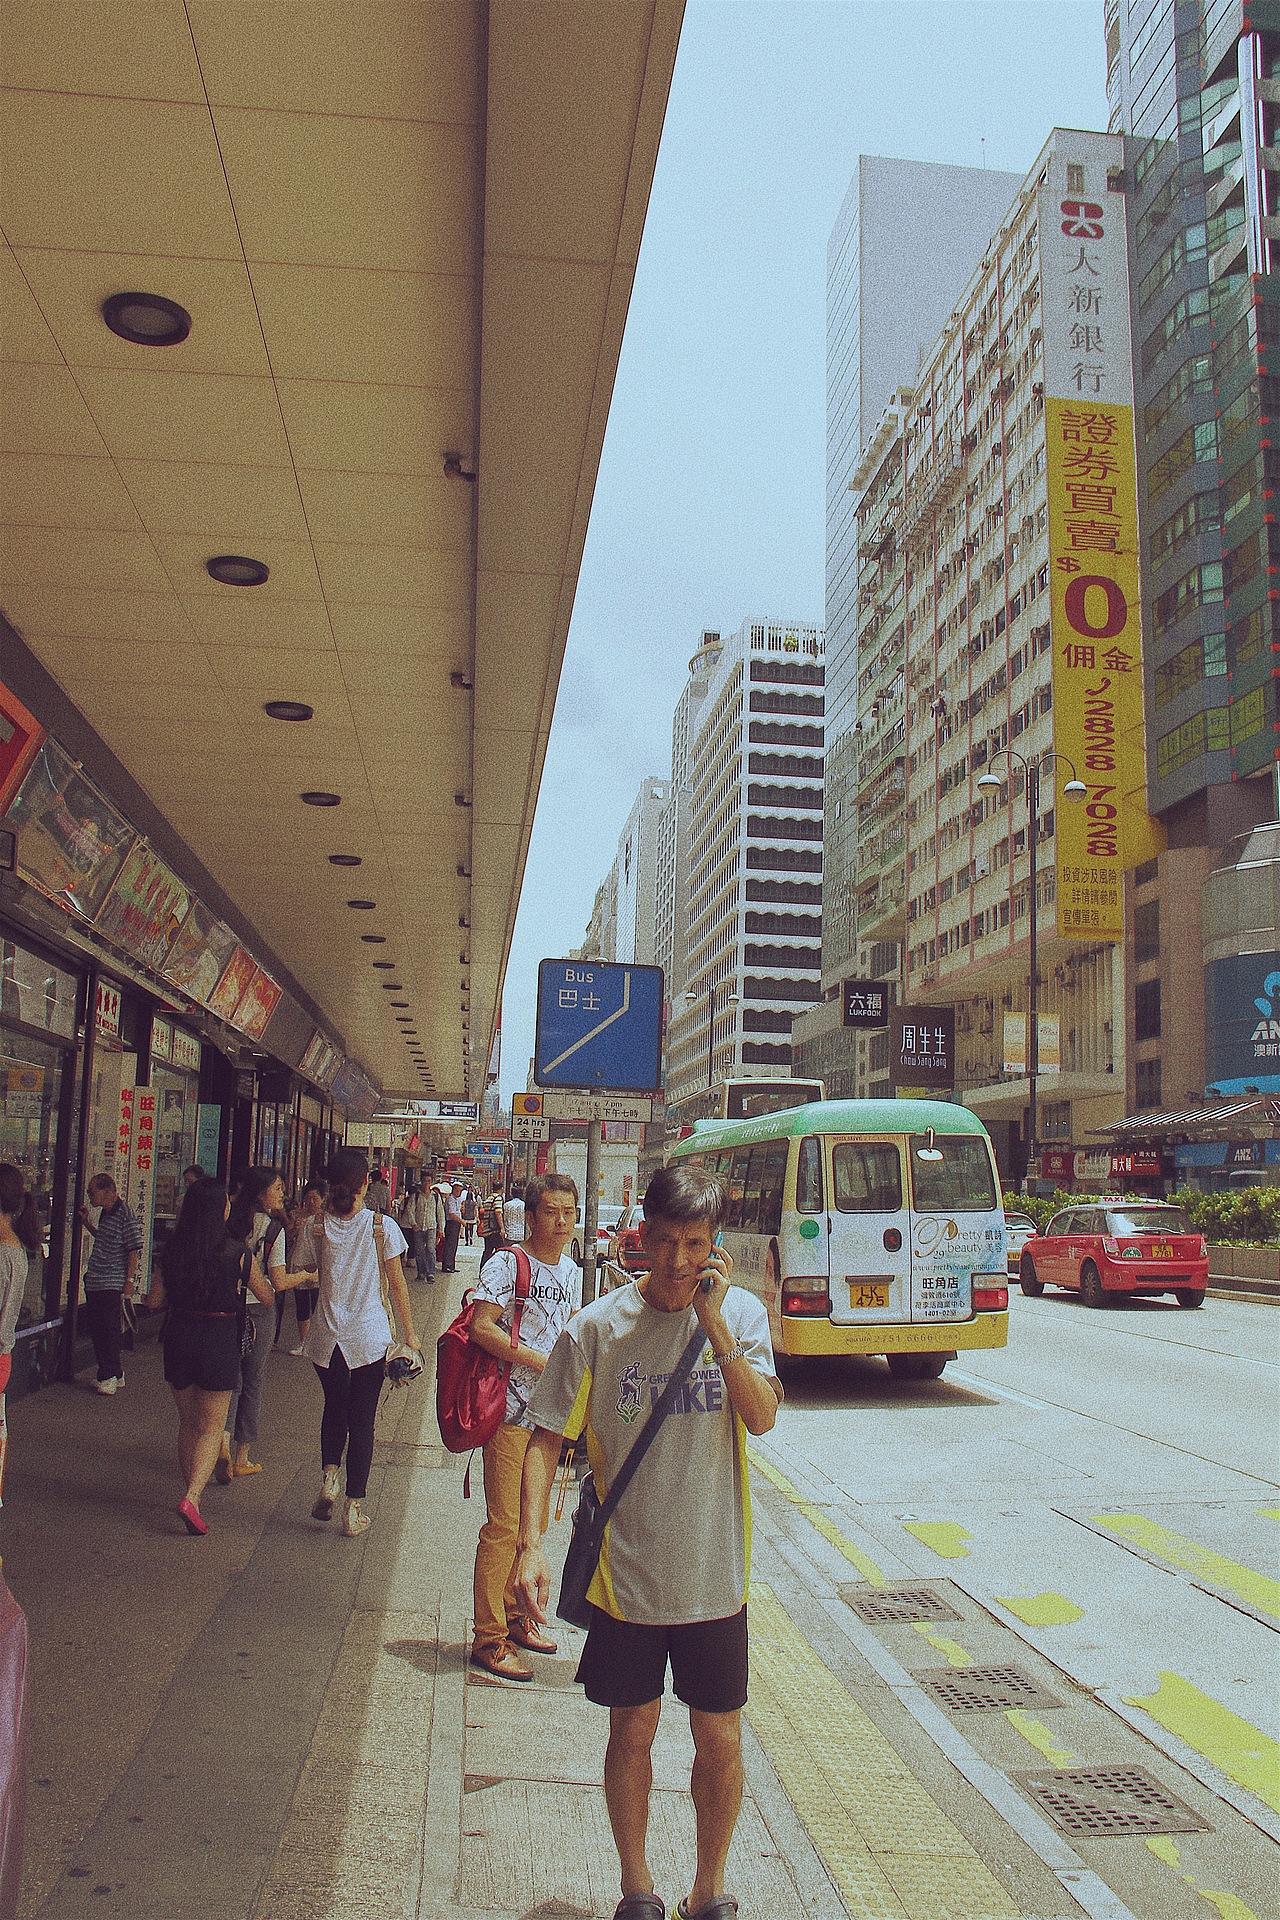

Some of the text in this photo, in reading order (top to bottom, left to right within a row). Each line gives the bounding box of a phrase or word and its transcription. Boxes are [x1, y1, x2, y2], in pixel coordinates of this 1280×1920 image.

[1066, 246, 1106, 394] 大新銀行
[1058, 409, 1122, 554] 證券買賣
[1062, 643, 1134, 673] 佣金
[565, 968, 594, 984] Bus
[558, 988, 601, 1011] 巴士
[850, 992, 882, 1010] 六福
[849, 1008, 882, 1018] LUKFOOK
[900, 1025, 946, 1055] 周生生
[1253, 1042, 1280, 1058] 澳新
[516, 1117, 546, 1127] 24 hrs
[519, 1128, 542, 1139] 全日
[1234, 1147, 1252, 1162] ANZ
[1111, 1157, 1132, 1172] 周大福
[947, 1241, 983, 1255] beauty
[922, 1276, 960, 1290] 旺角店
[860, 1285, 879, 1298] LK
[856, 1295, 885, 1307] 475
[689, 1369, 721, 1381] OWER
